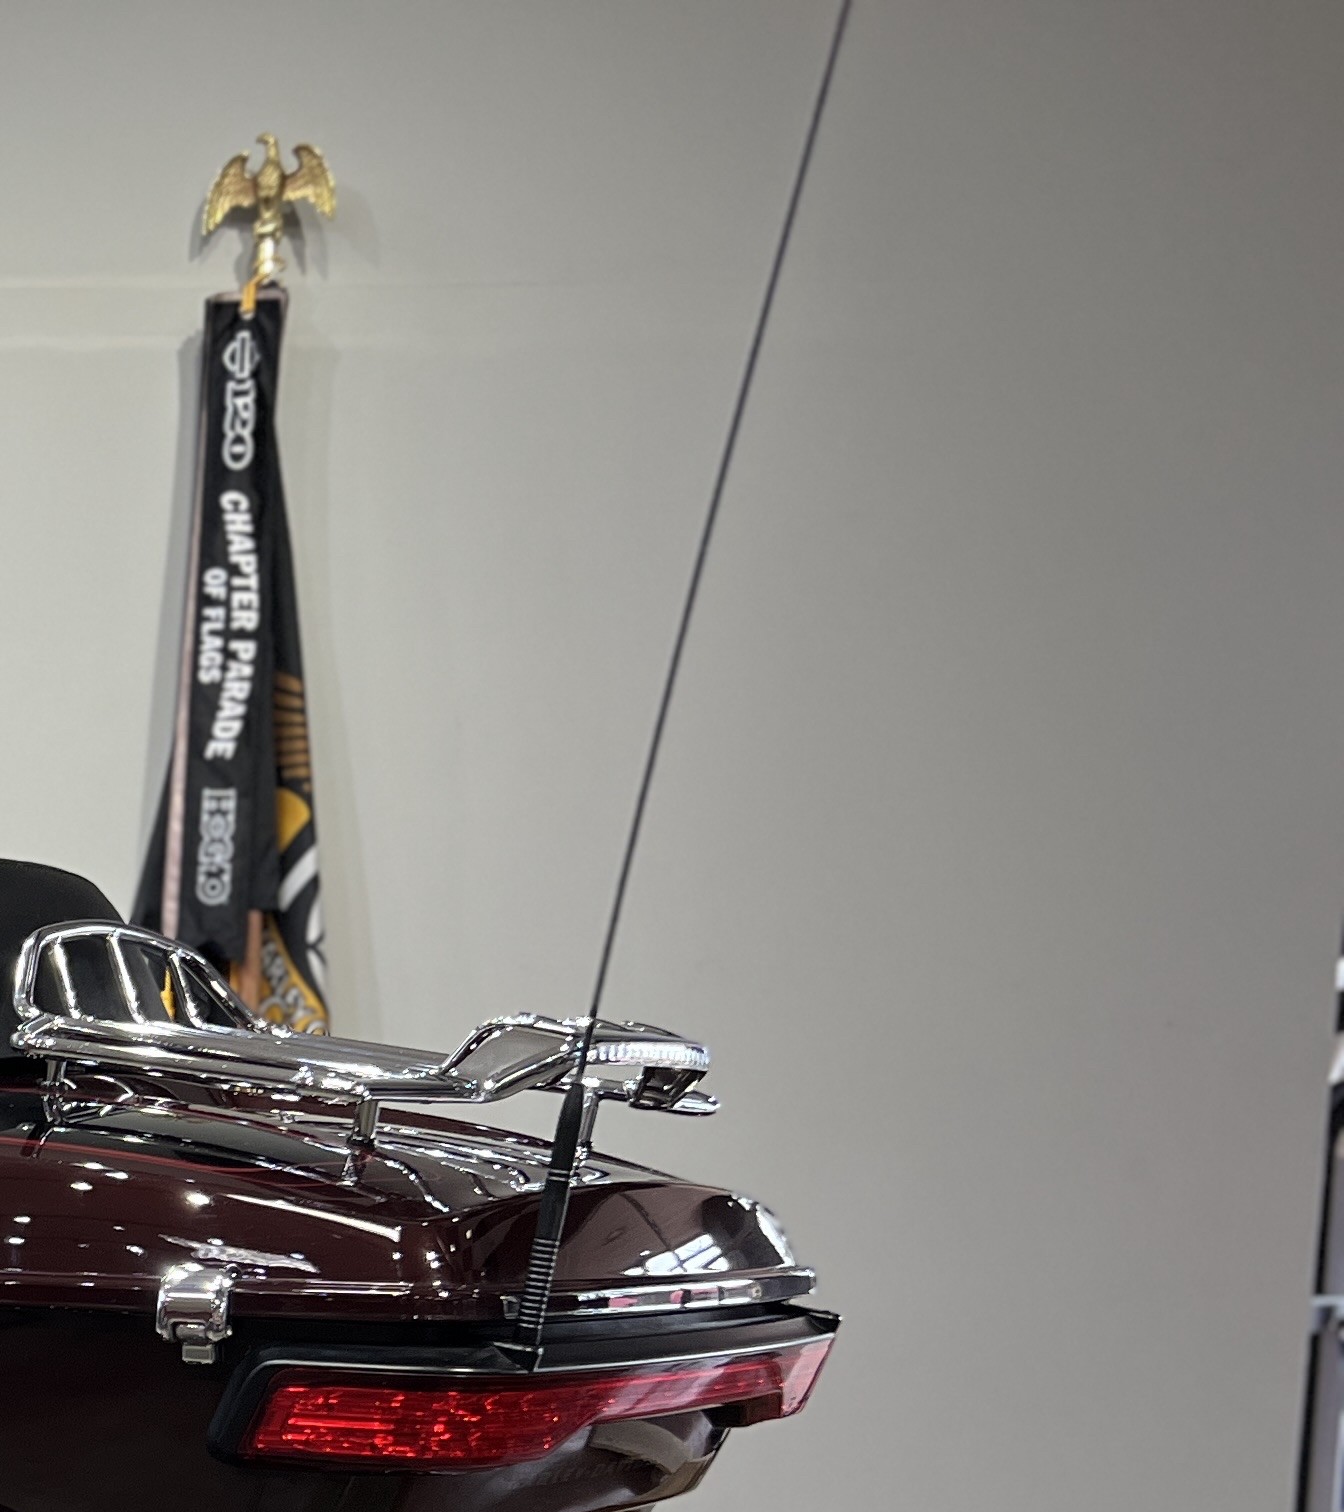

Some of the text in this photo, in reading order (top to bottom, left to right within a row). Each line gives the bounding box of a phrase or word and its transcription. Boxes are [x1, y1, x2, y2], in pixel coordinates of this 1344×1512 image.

[197, 566, 229, 684] OF FLAGS
[203, 489, 260, 761] CHAPTER PARADE
